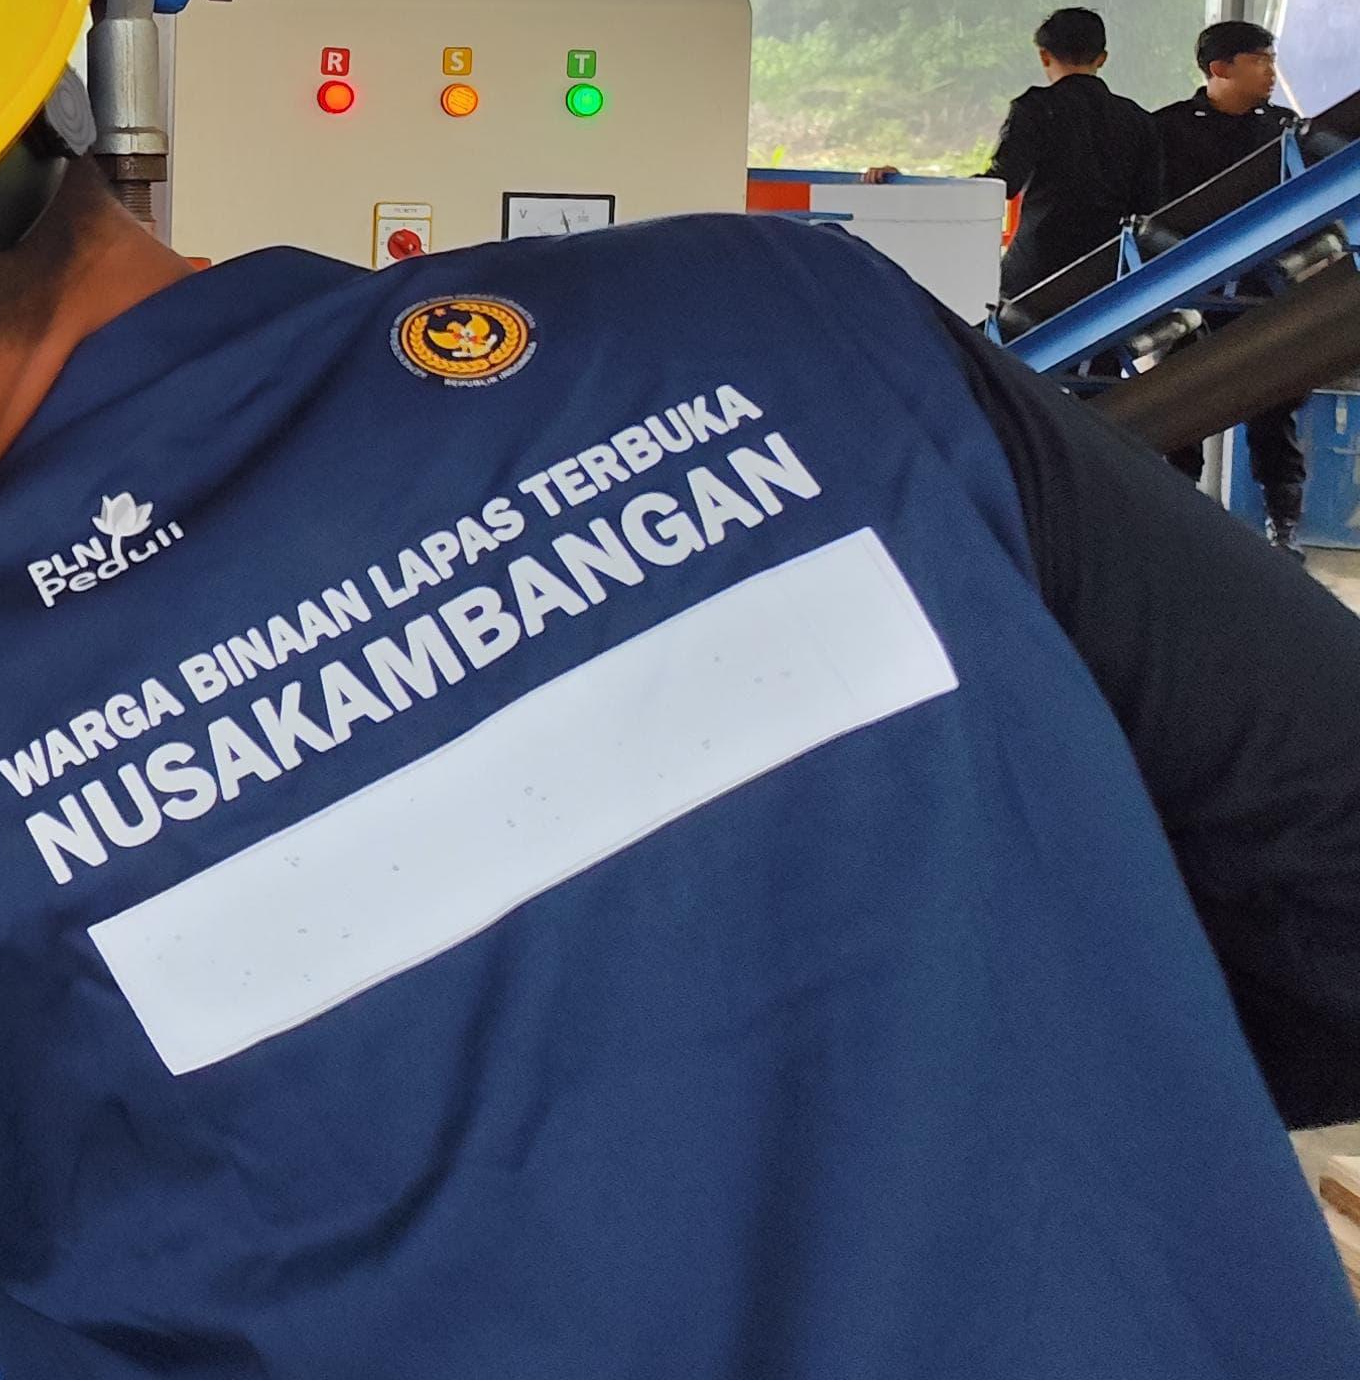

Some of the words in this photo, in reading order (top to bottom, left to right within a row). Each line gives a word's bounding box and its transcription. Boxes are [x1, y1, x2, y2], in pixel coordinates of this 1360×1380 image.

[327, 51, 343, 72] R
[450, 51, 465, 72] S
[574, 53, 590, 74] T
[28, 536, 107, 587] PLN
[37, 521, 185, 608] Peduli
[179, 579, 372, 704] BINAAN
[368, 496, 525, 608] LAPAS
[518, 384, 763, 517] TERBUKA
[25, 432, 822, 885] NUSAKAMBANGAN
